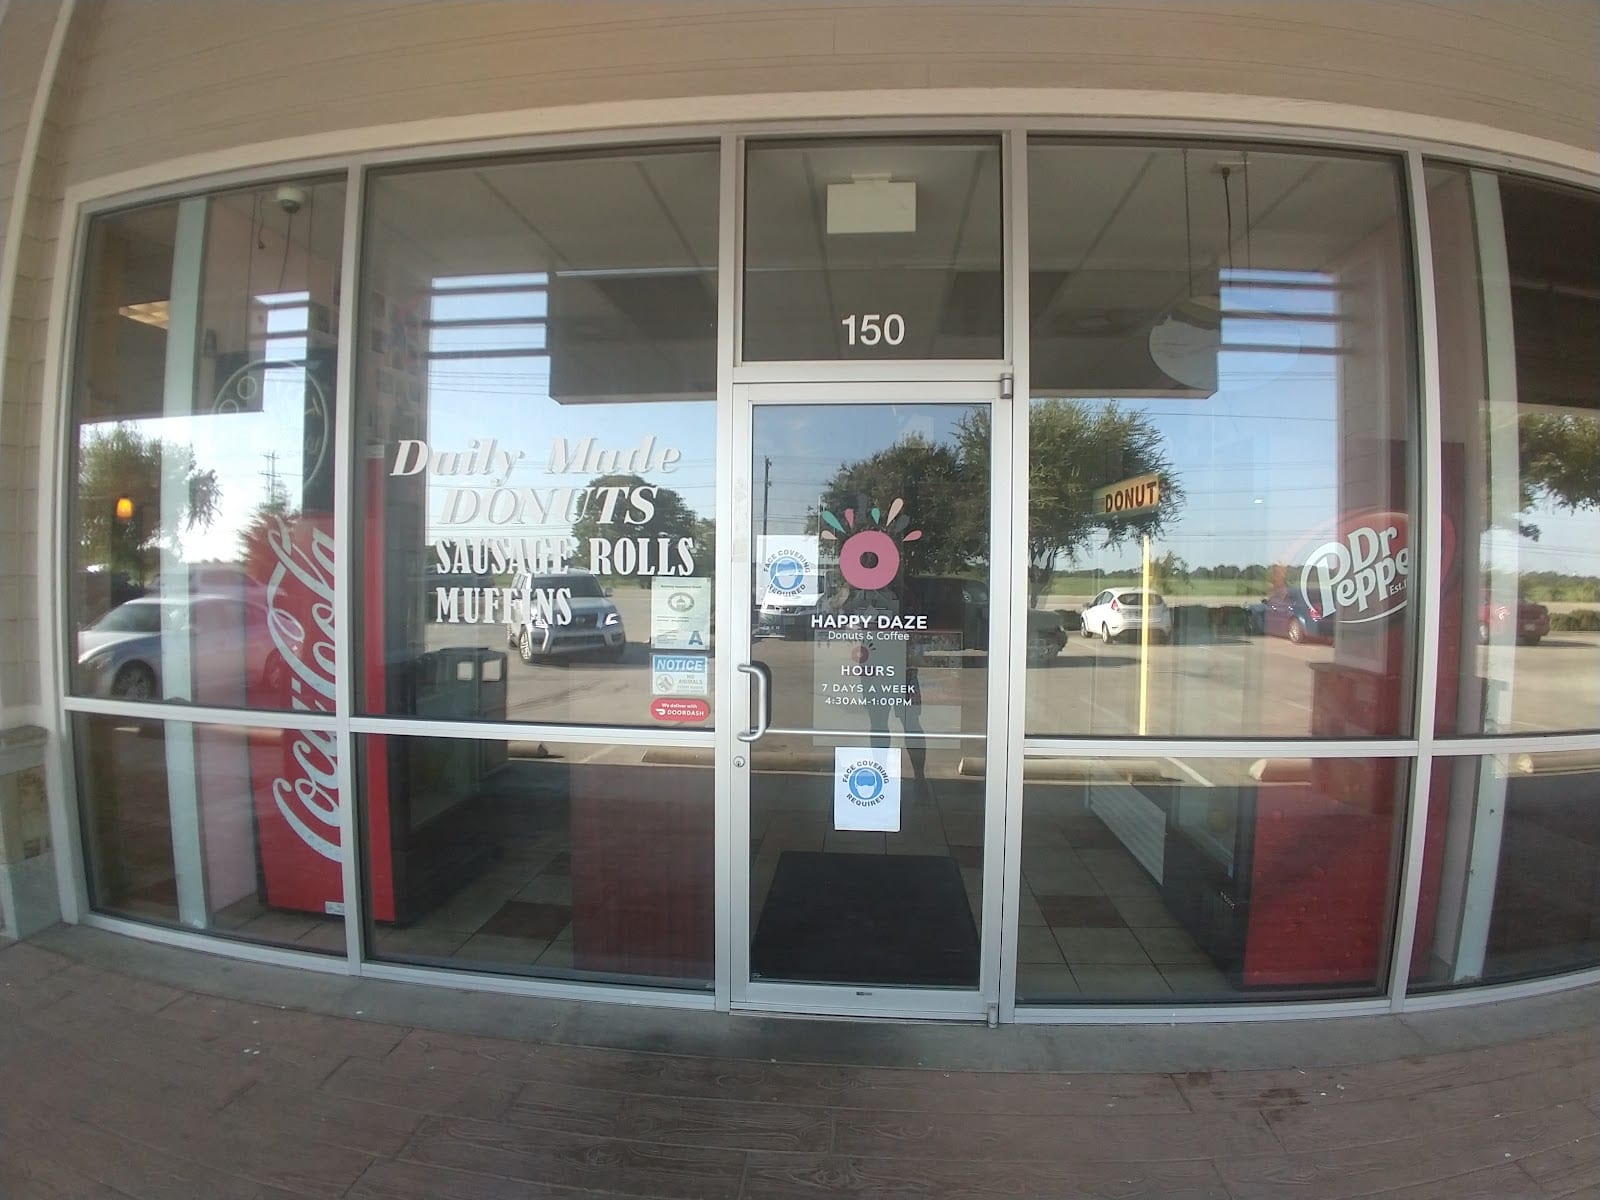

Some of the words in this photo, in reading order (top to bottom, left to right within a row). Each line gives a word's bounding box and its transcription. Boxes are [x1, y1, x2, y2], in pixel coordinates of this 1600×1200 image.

[841, 313, 906, 346] 150
[388, 437, 526, 487] Daily
[542, 435, 682, 476] Made
[437, 485, 660, 525] DONUTS
[1105, 481, 1157, 513] DONUT
[435, 536, 570, 576] SAUSAGE
[588, 537, 696, 577] ROLLS
[1347, 526, 1398, 574] Dr
[763, 553, 778, 573] FACE
[778, 548, 811, 573] COVERING
[1300, 541, 1409, 618] Peppe
[768, 583, 806, 598] REQUIRED
[435, 586, 573, 626] MUFFINS
[810, 614, 873, 630] HAPPY
[877, 615, 928, 630] DAZE
[688, 630, 704, 646] A
[828, 630, 864, 641] Donuts
[866, 631, 874, 641] &
[876, 631, 910, 641] Coffee
[656, 658, 704, 672] NOTICE
[840, 665, 896, 677] HOURS
[821, 683, 828, 693] 7
[832, 684, 864, 693] DAYS
[868, 684, 877, 693] A
[880, 684, 916, 694] WEEK
[824, 697, 913, 707] 4:30AM-1:00PM
[666, 709, 705, 717] DOORDASH
[842, 764, 856, 783] FACE
[856, 760, 890, 784] COVERING
[846, 793, 885, 808] REQUIRED
